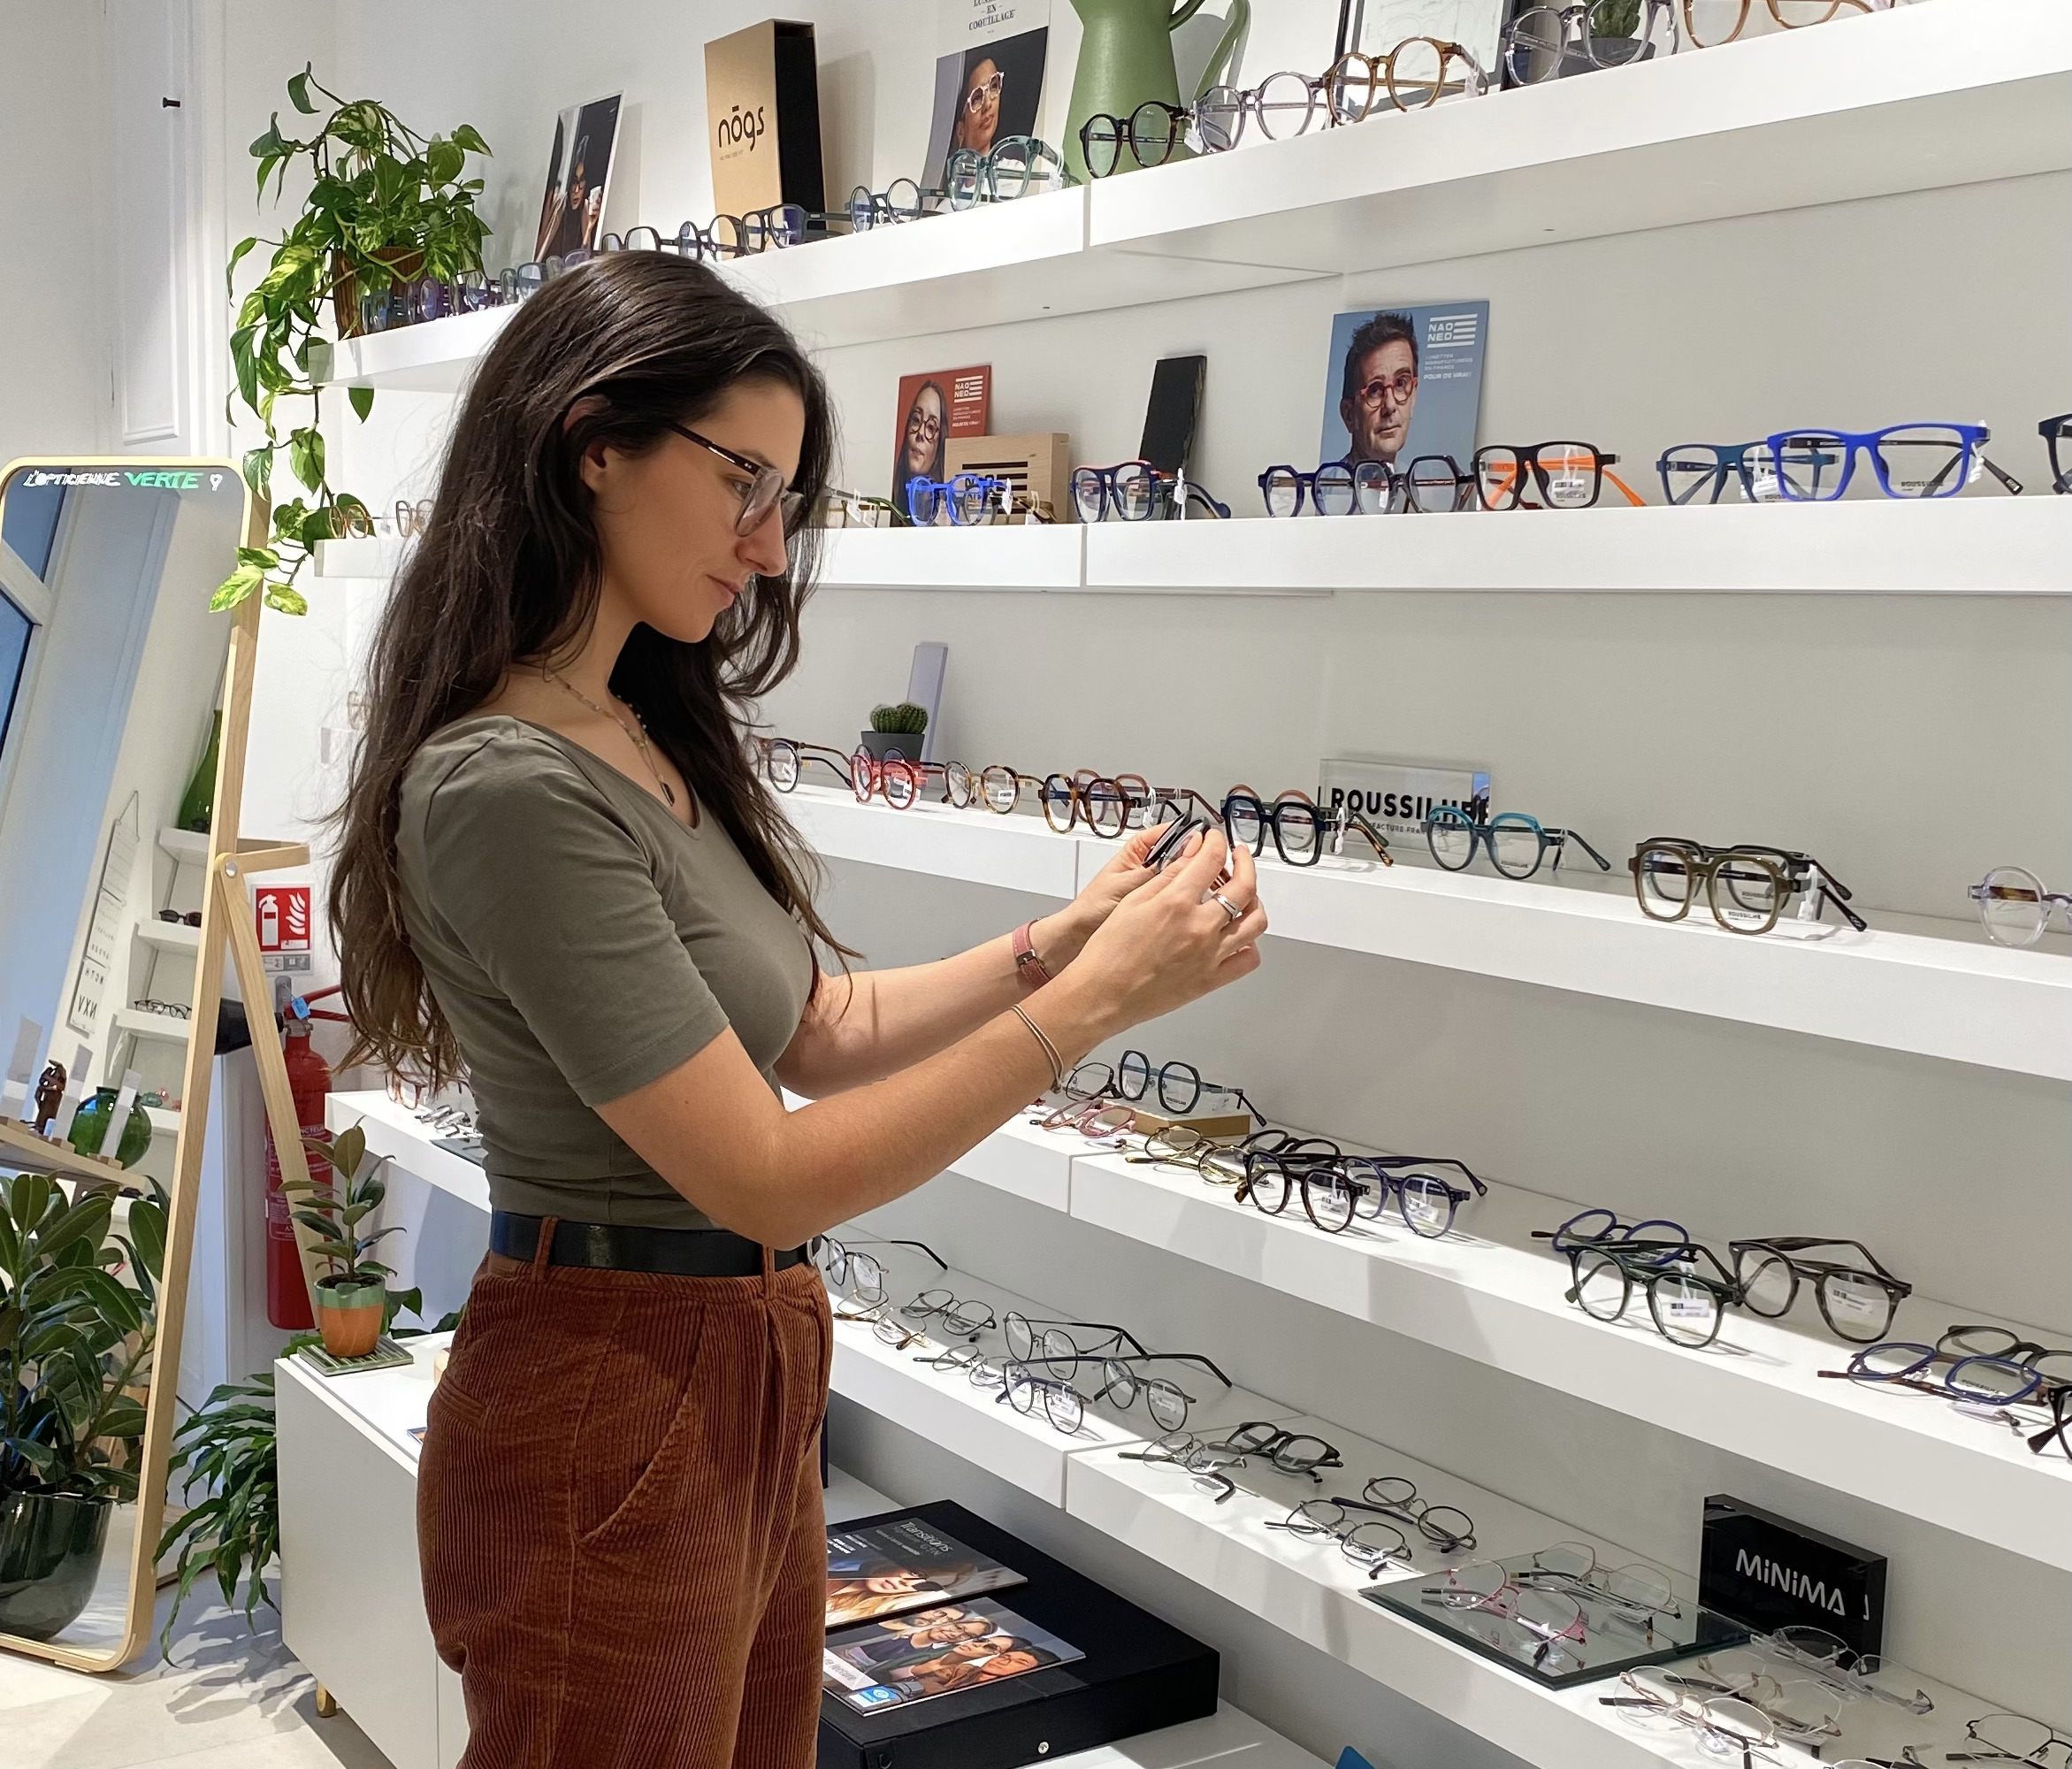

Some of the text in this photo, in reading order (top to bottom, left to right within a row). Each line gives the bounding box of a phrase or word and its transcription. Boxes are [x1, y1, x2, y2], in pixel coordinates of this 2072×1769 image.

[968, 9, 1016, 31] COQUILLAGE
[718, 104, 765, 152] nōgs
[1428, 322, 1454, 333] NAO
[124, 471, 203, 489] VERTE
